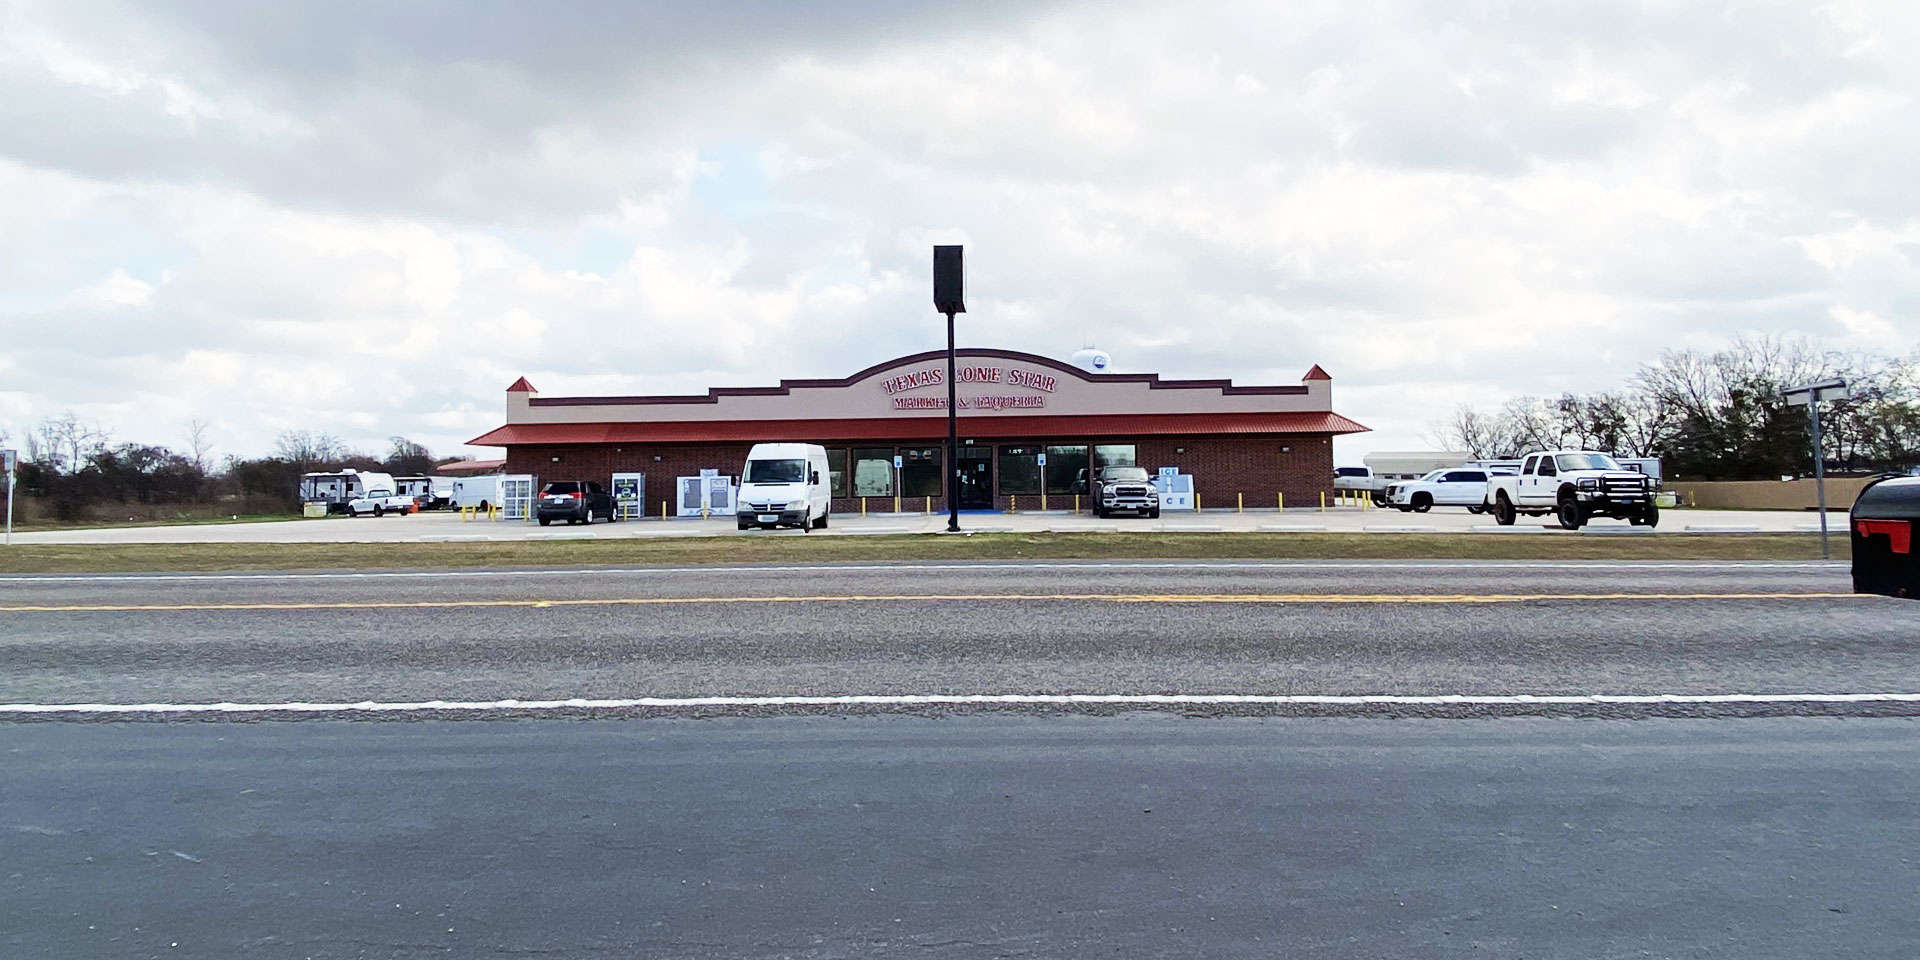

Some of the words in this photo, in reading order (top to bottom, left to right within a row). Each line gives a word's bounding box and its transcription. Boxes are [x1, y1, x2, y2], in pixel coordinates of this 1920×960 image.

[883, 367, 943, 395] TEXAS
[1008, 369, 1056, 393] STAR
[975, 396, 1044, 410] TAQUERIA
